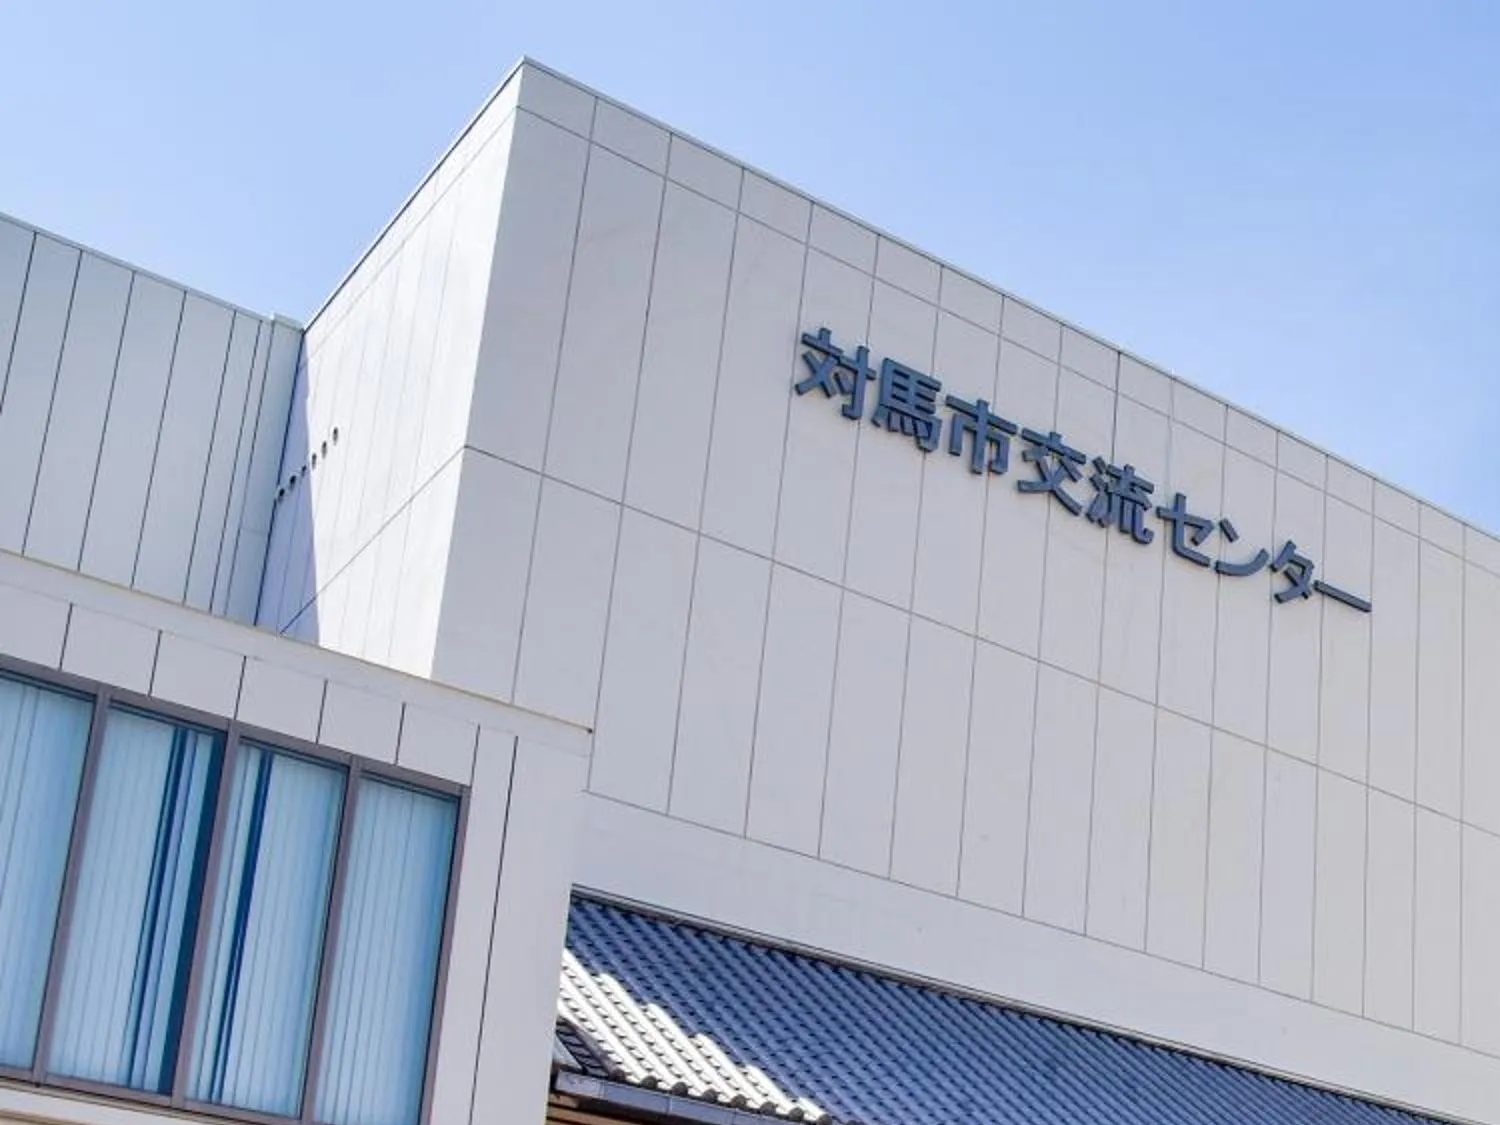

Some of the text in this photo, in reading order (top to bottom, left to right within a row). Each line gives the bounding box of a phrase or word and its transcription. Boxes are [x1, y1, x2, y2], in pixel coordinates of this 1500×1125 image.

[795, 327, 1373, 613] 対馬市交流センター
